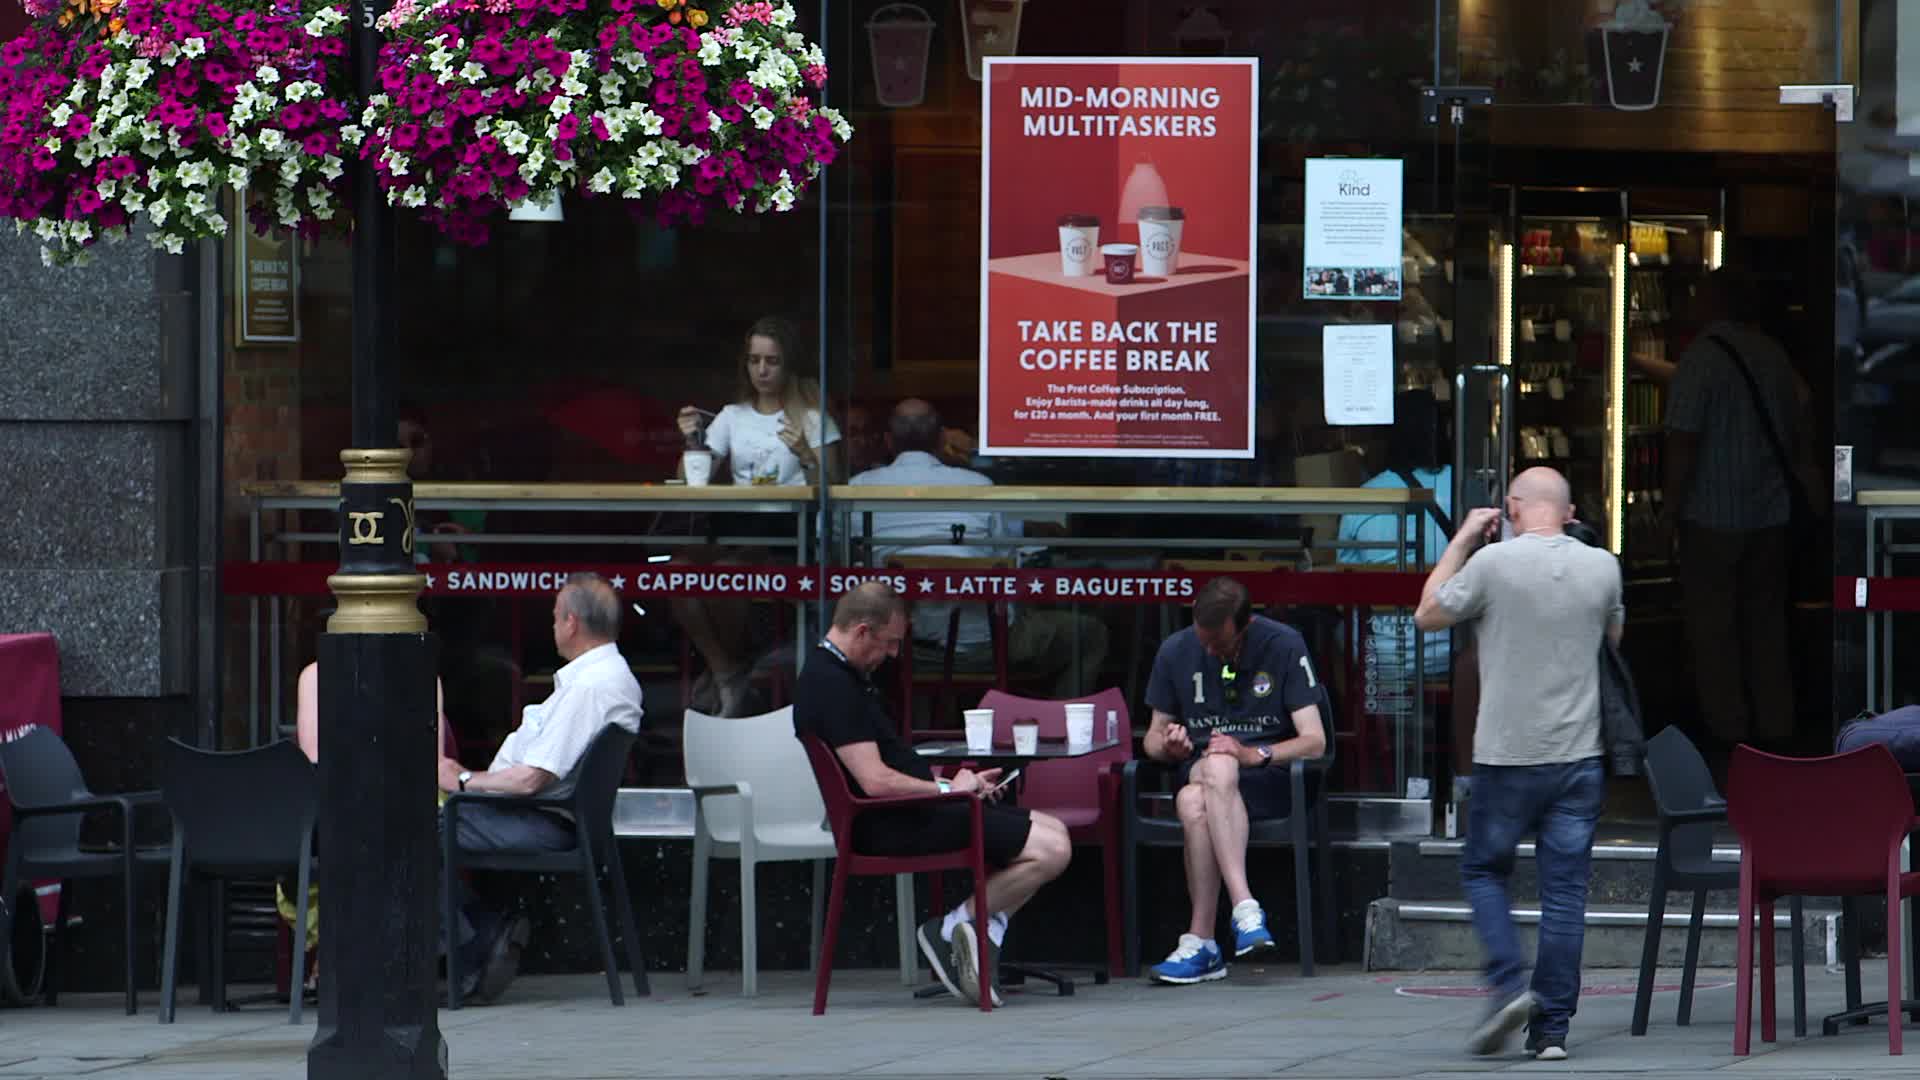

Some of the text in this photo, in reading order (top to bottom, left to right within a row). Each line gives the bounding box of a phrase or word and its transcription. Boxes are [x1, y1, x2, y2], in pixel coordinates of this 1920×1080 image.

[1020, 87, 1221, 109] MID-MORNING
[1023, 115, 1217, 137] MULTITASKERS
[1339, 183, 1370, 196] Kind
[1017, 321, 1218, 344] TAKE BACK THE
[1019, 349, 1210, 372] COFFEE BREAK
[1047, 384, 1186, 396] The Pret Coffee Subscription.
[1025, 396, 1053, 408] Enjoy
[1118, 397, 1149, 408] drinks
[1150, 398, 1163, 408] all
[1163, 399, 1183, 410] day
[1013, 409, 1029, 419] for
[1093, 410, 1115, 420] And
[1115, 413, 1138, 423] your
[1139, 411, 1160, 421] first
[1160, 411, 1193, 421] month
[447, 571, 569, 591] SANDWICH
[637, 572, 787, 592] CAPPUCCINO
[945, 576, 1017, 595] LATTE
[1056, 578, 1194, 596] BAGUETTES
[1299, 655, 1316, 688] 1
[1192, 671, 1206, 704] 1
